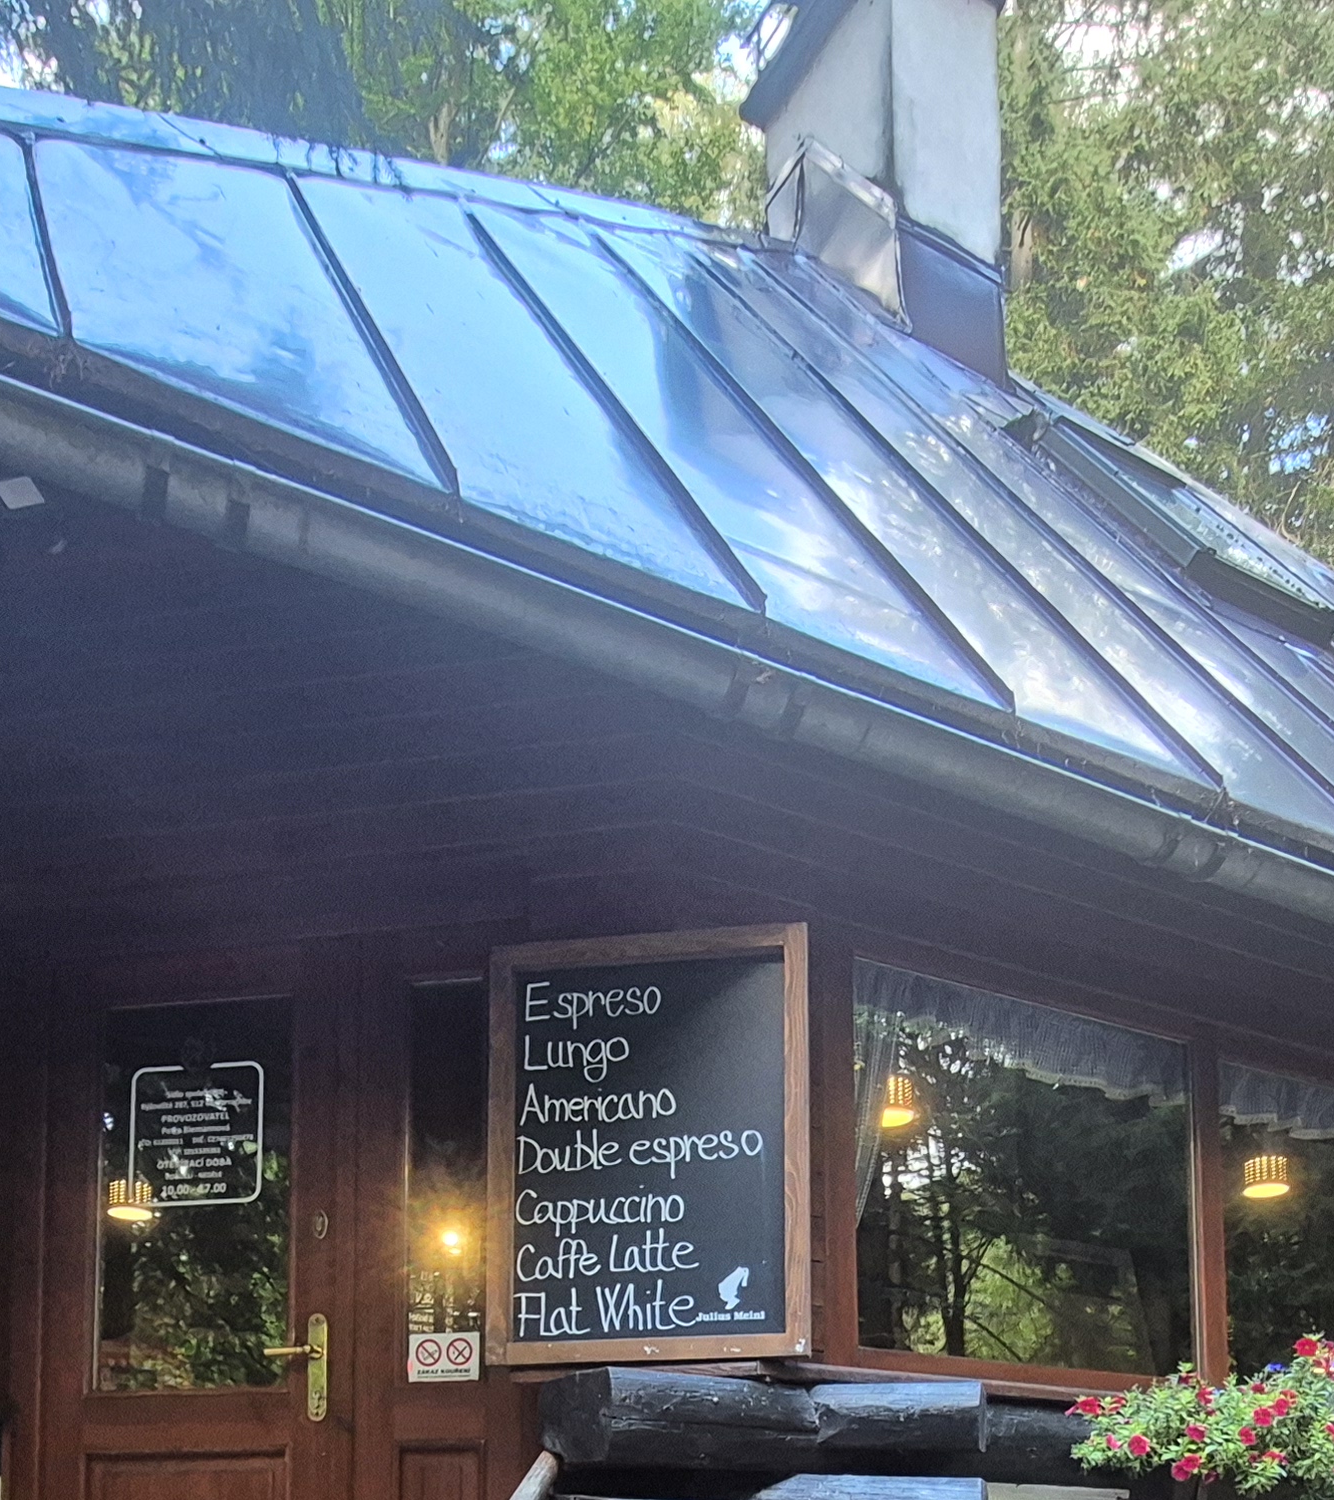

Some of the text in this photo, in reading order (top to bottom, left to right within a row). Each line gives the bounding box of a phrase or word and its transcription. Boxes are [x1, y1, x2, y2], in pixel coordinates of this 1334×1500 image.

[524, 980, 662, 1030] Espreso
[523, 1034, 630, 1083] Lungo
[519, 1082, 677, 1127] Americano
[516, 1128, 763, 1179] Double espreso
[515, 1184, 685, 1237] Cappuccino
[516, 1228, 699, 1282] Caffe Latte
[513, 1279, 697, 1338] Flat White
[696, 1310, 766, 1322] Julius Meinl
